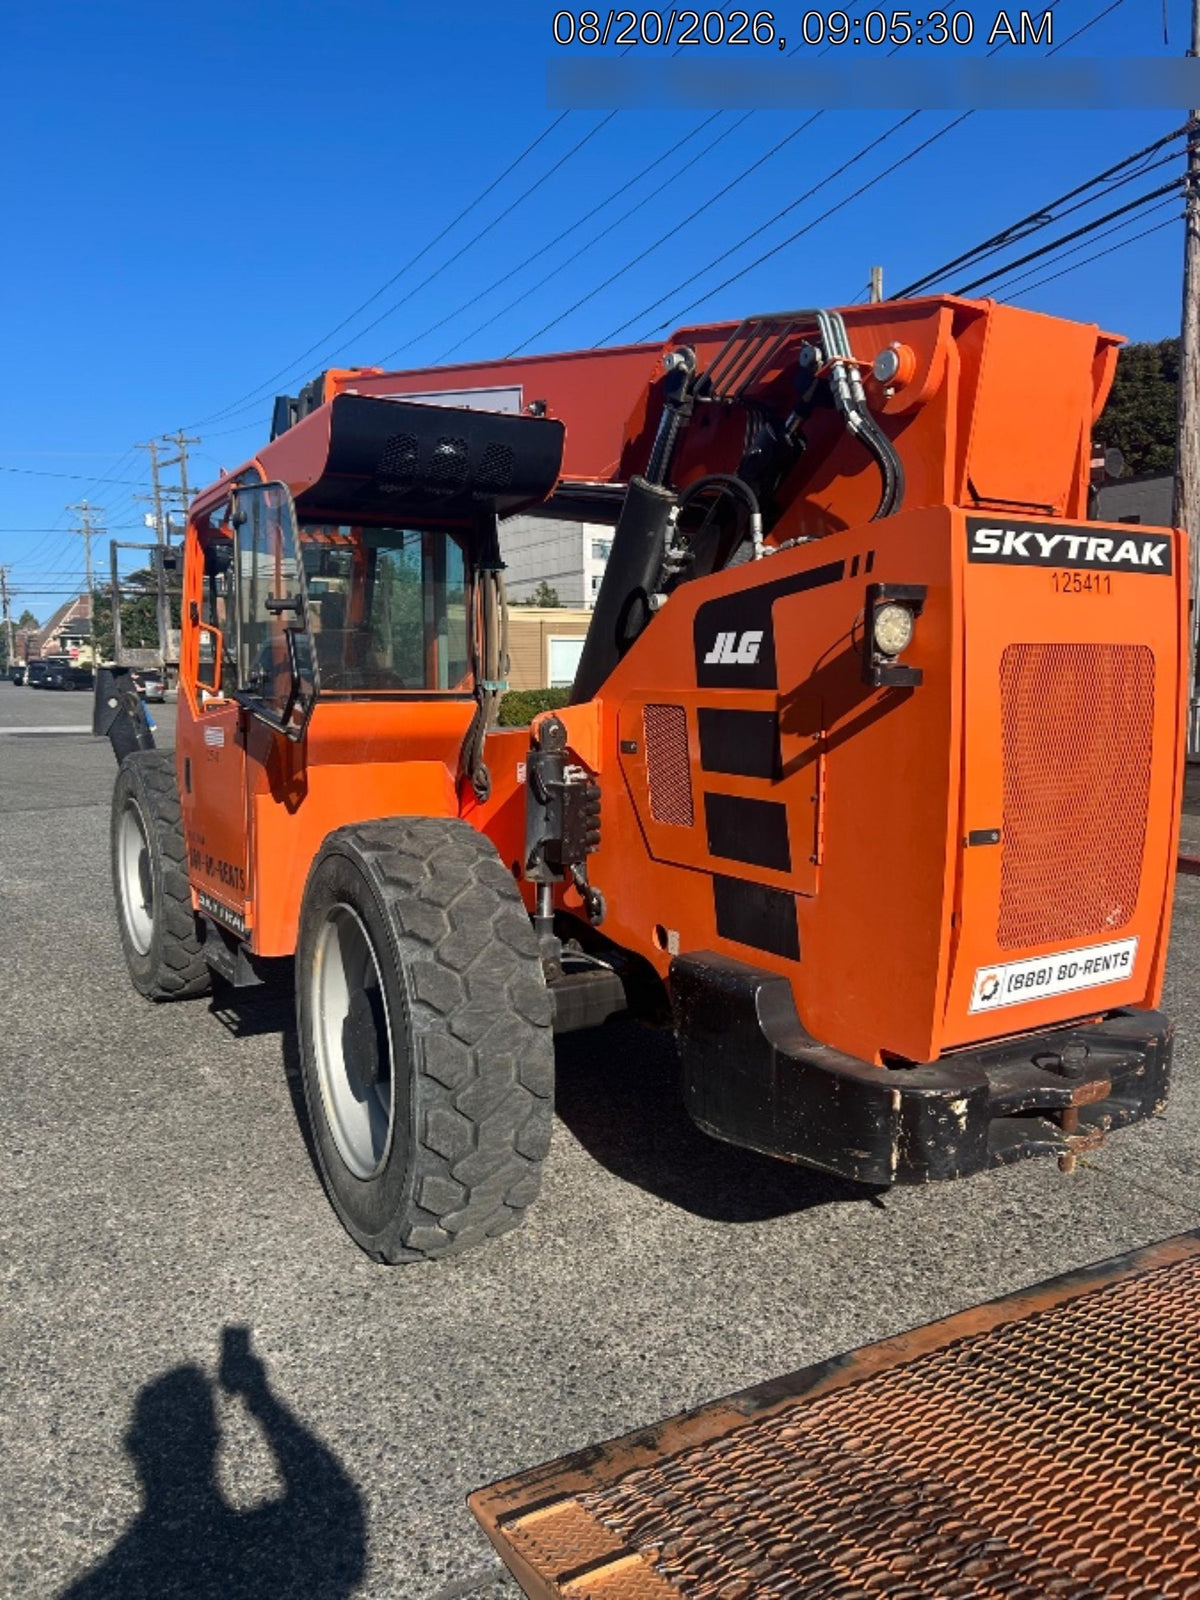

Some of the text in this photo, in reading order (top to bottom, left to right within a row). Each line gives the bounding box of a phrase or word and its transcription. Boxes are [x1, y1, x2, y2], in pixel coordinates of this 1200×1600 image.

[971, 528, 1167, 566] SKYTRAK
[1052, 572, 1111, 594] 125411
[703, 630, 764, 664] JLG
[1007, 951, 1130, 993] (888) 80-RENTS
